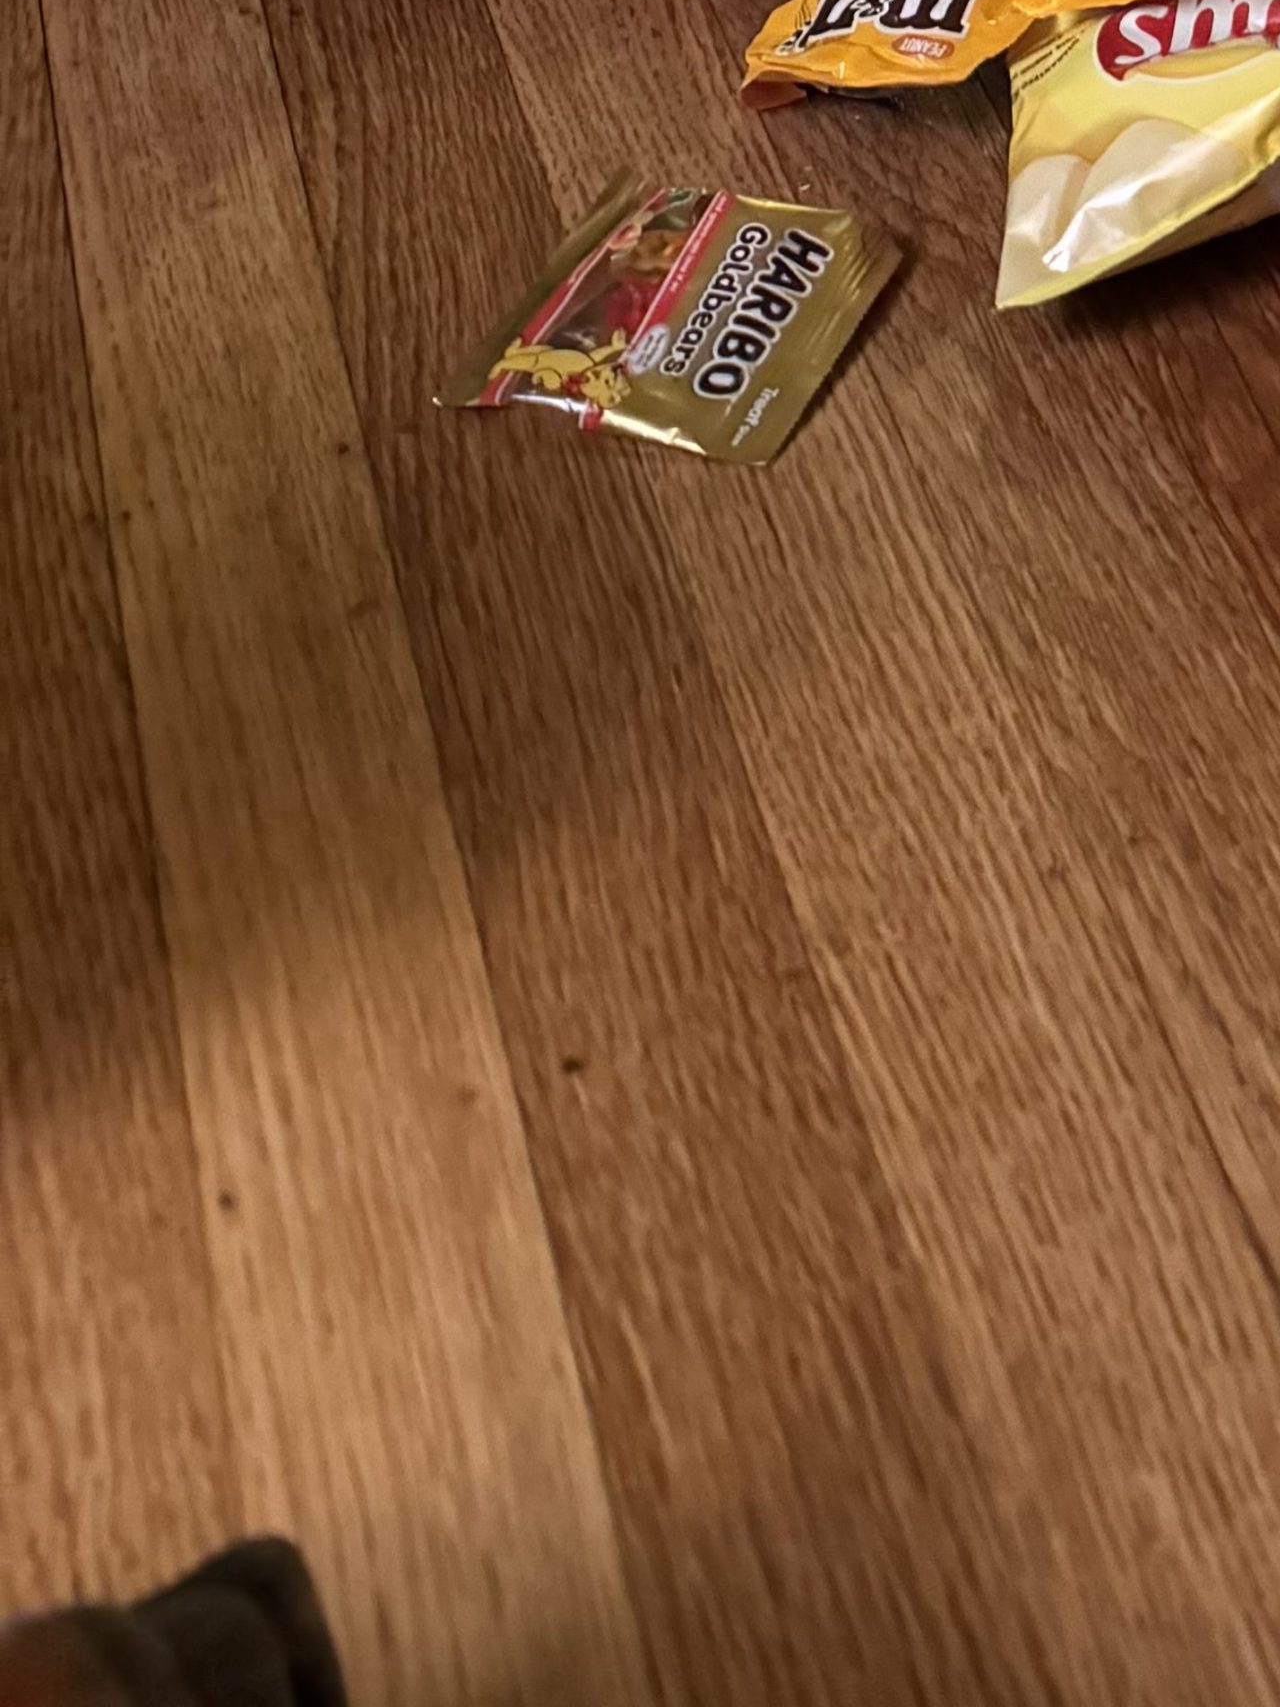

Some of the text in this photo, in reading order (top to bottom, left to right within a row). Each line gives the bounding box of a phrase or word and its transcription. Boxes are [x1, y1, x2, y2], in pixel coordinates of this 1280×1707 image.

[895, 35, 949, 58] PEANUT
[657, 221, 771, 377] Goldbears
[693, 227, 835, 401] HARIBO
[745, 386, 781, 428] Treat
